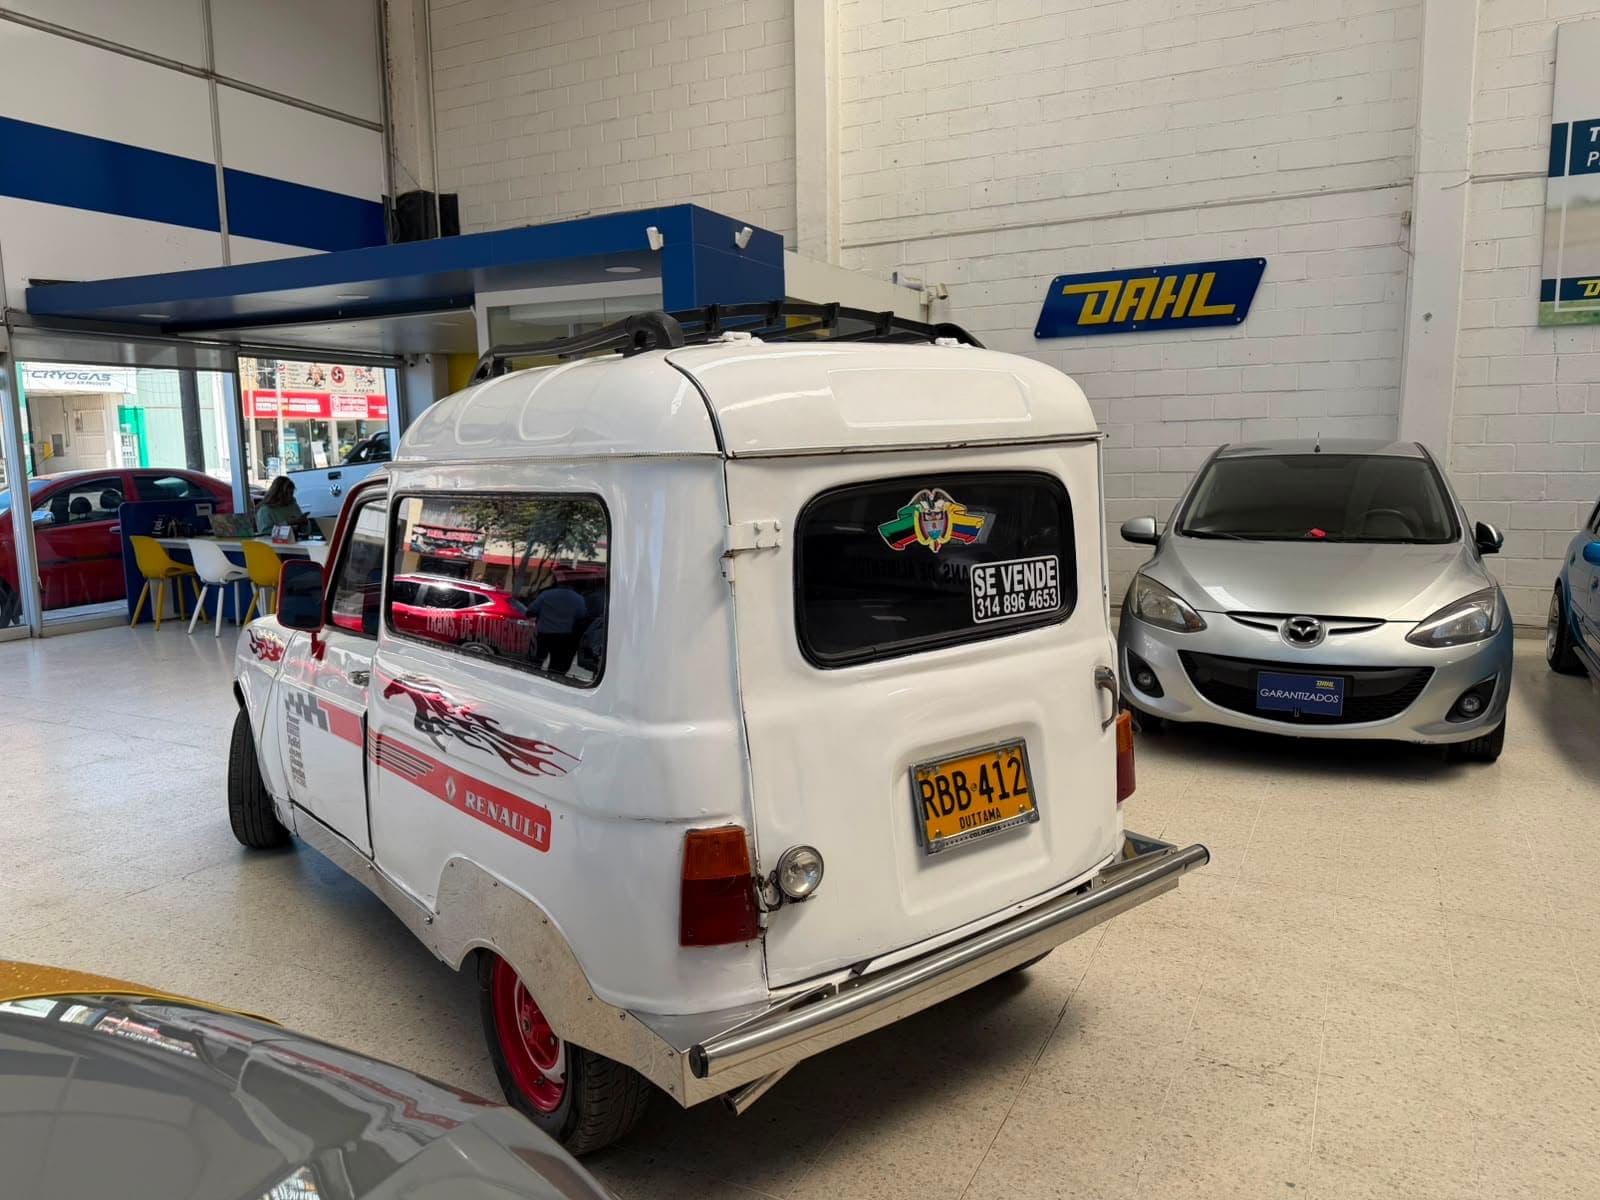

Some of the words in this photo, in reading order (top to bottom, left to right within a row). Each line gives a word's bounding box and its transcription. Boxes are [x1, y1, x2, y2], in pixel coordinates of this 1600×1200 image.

[1062, 272, 1236, 326] DAHL
[31, 370, 112, 381] CRYOGAS
[974, 567, 997, 597] SE
[1000, 560, 1057, 593] VENDE
[977, 595, 1001, 618] 314
[1003, 592, 1026, 614] 896
[1028, 587, 1057, 609] 4653
[1260, 688, 1339, 703] GARANTIZADOS
[464, 789, 547, 843] RENAULT
[968, 825, 1002, 839] COLOMBIA
